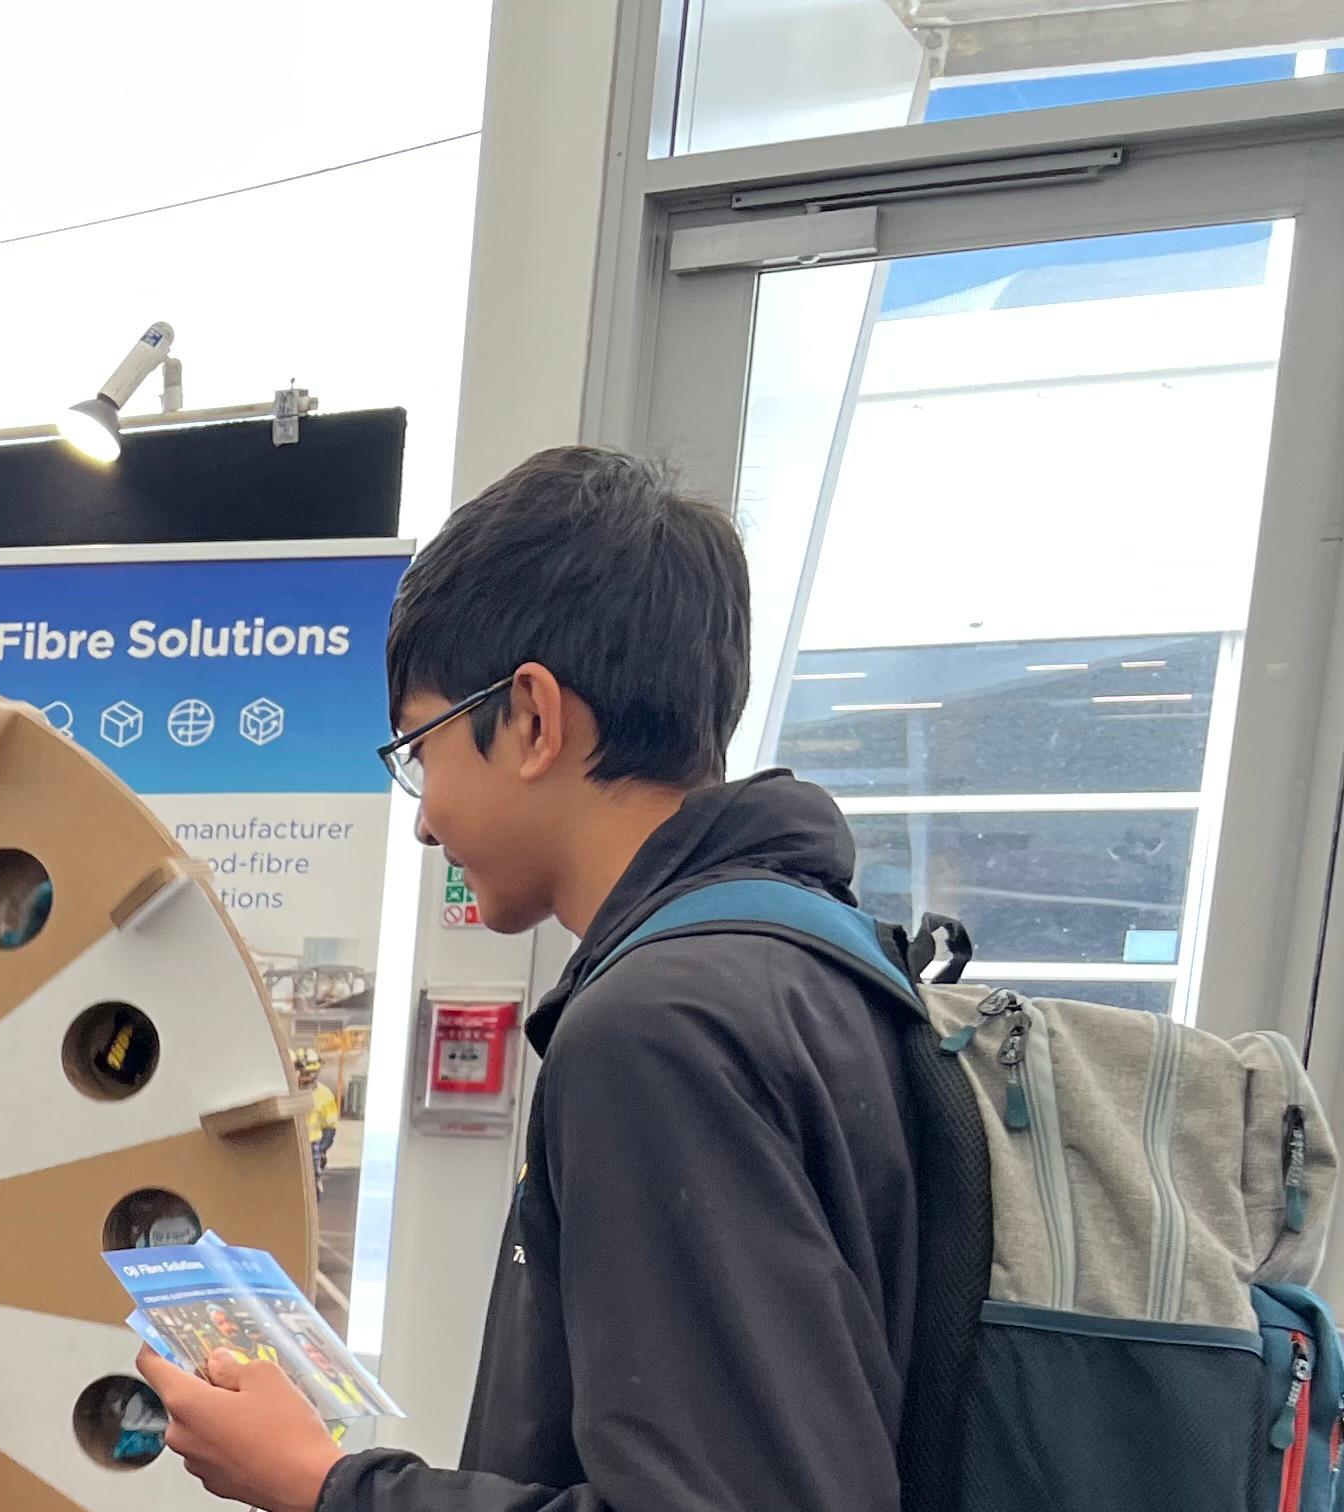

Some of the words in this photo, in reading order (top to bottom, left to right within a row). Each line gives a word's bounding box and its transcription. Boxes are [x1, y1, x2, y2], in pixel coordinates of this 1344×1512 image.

[127, 617, 350, 660] Solutions
[175, 817, 354, 840] manufacturer
[208, 851, 309, 874] od-fibre
[219, 887, 283, 910] tions
